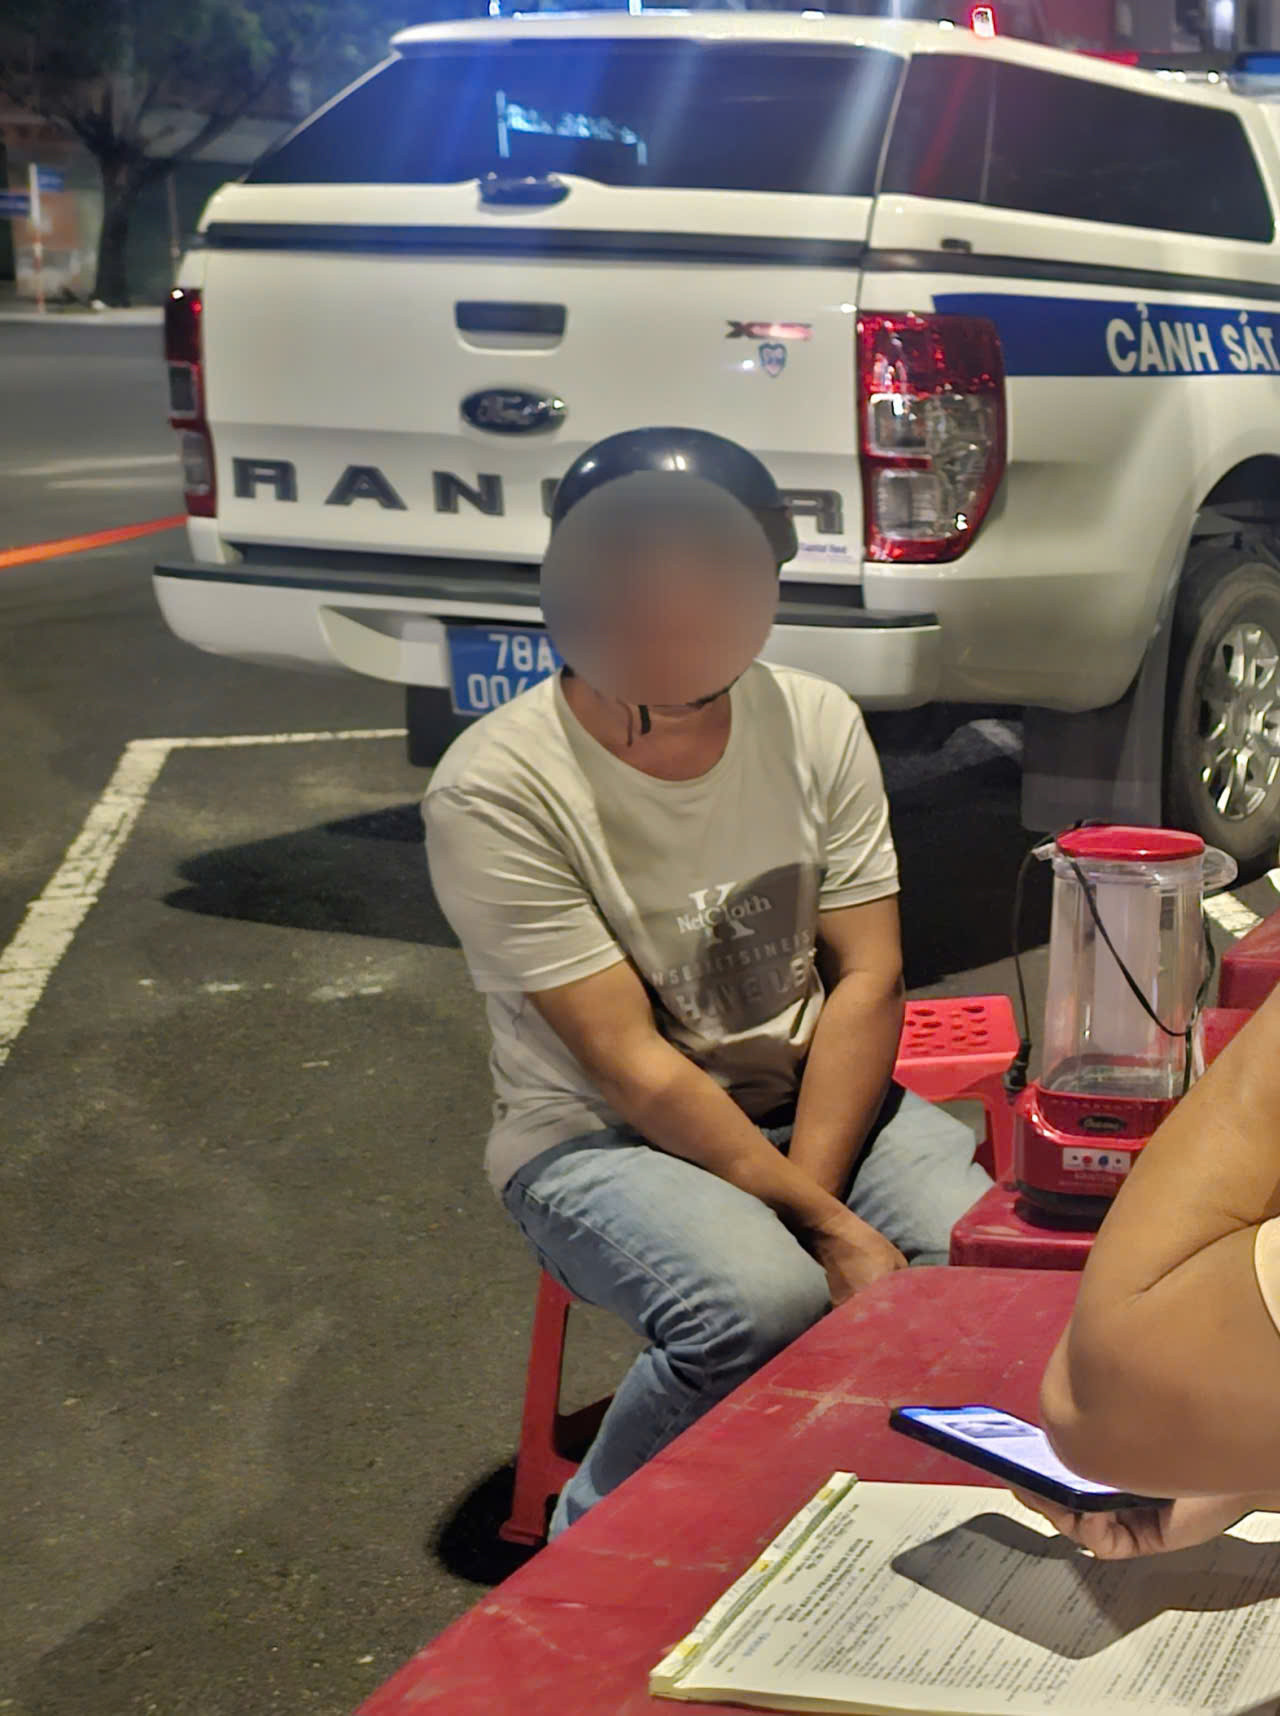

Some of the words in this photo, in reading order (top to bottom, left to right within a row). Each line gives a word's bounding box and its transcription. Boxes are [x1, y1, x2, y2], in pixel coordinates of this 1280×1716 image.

[1106, 301, 1220, 373] CẢNH
[232, 457, 844, 535] RANR
[488, 633, 556, 673] 78A
